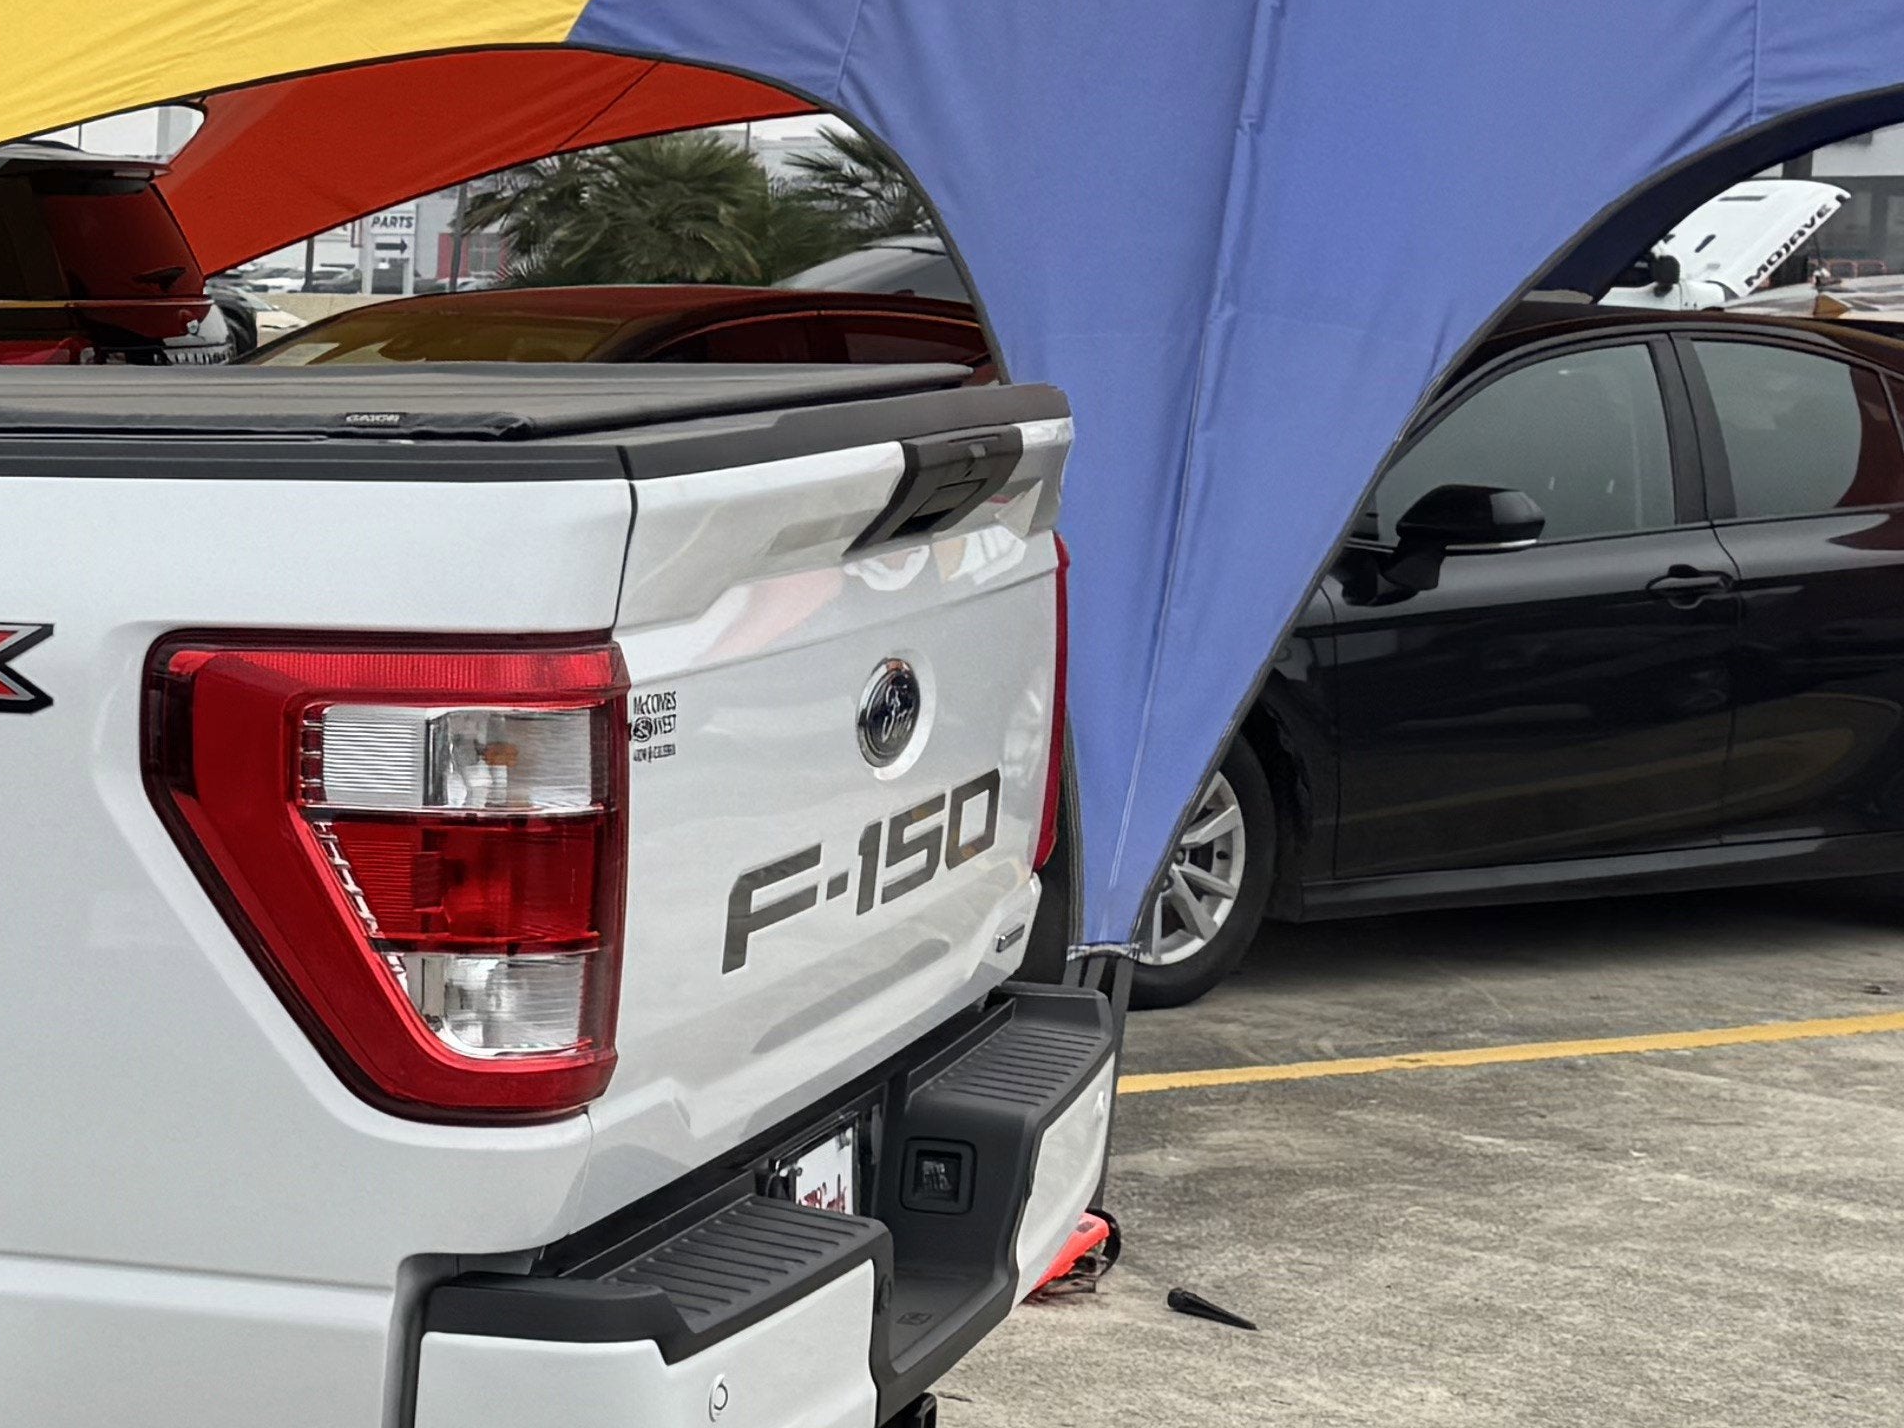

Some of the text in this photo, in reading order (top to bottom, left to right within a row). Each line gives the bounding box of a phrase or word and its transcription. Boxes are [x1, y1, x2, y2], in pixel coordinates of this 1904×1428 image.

[370, 215, 415, 229] PARTS
[1744, 203, 1832, 288] MOJAVE
[721, 768, 1001, 974] F-150
